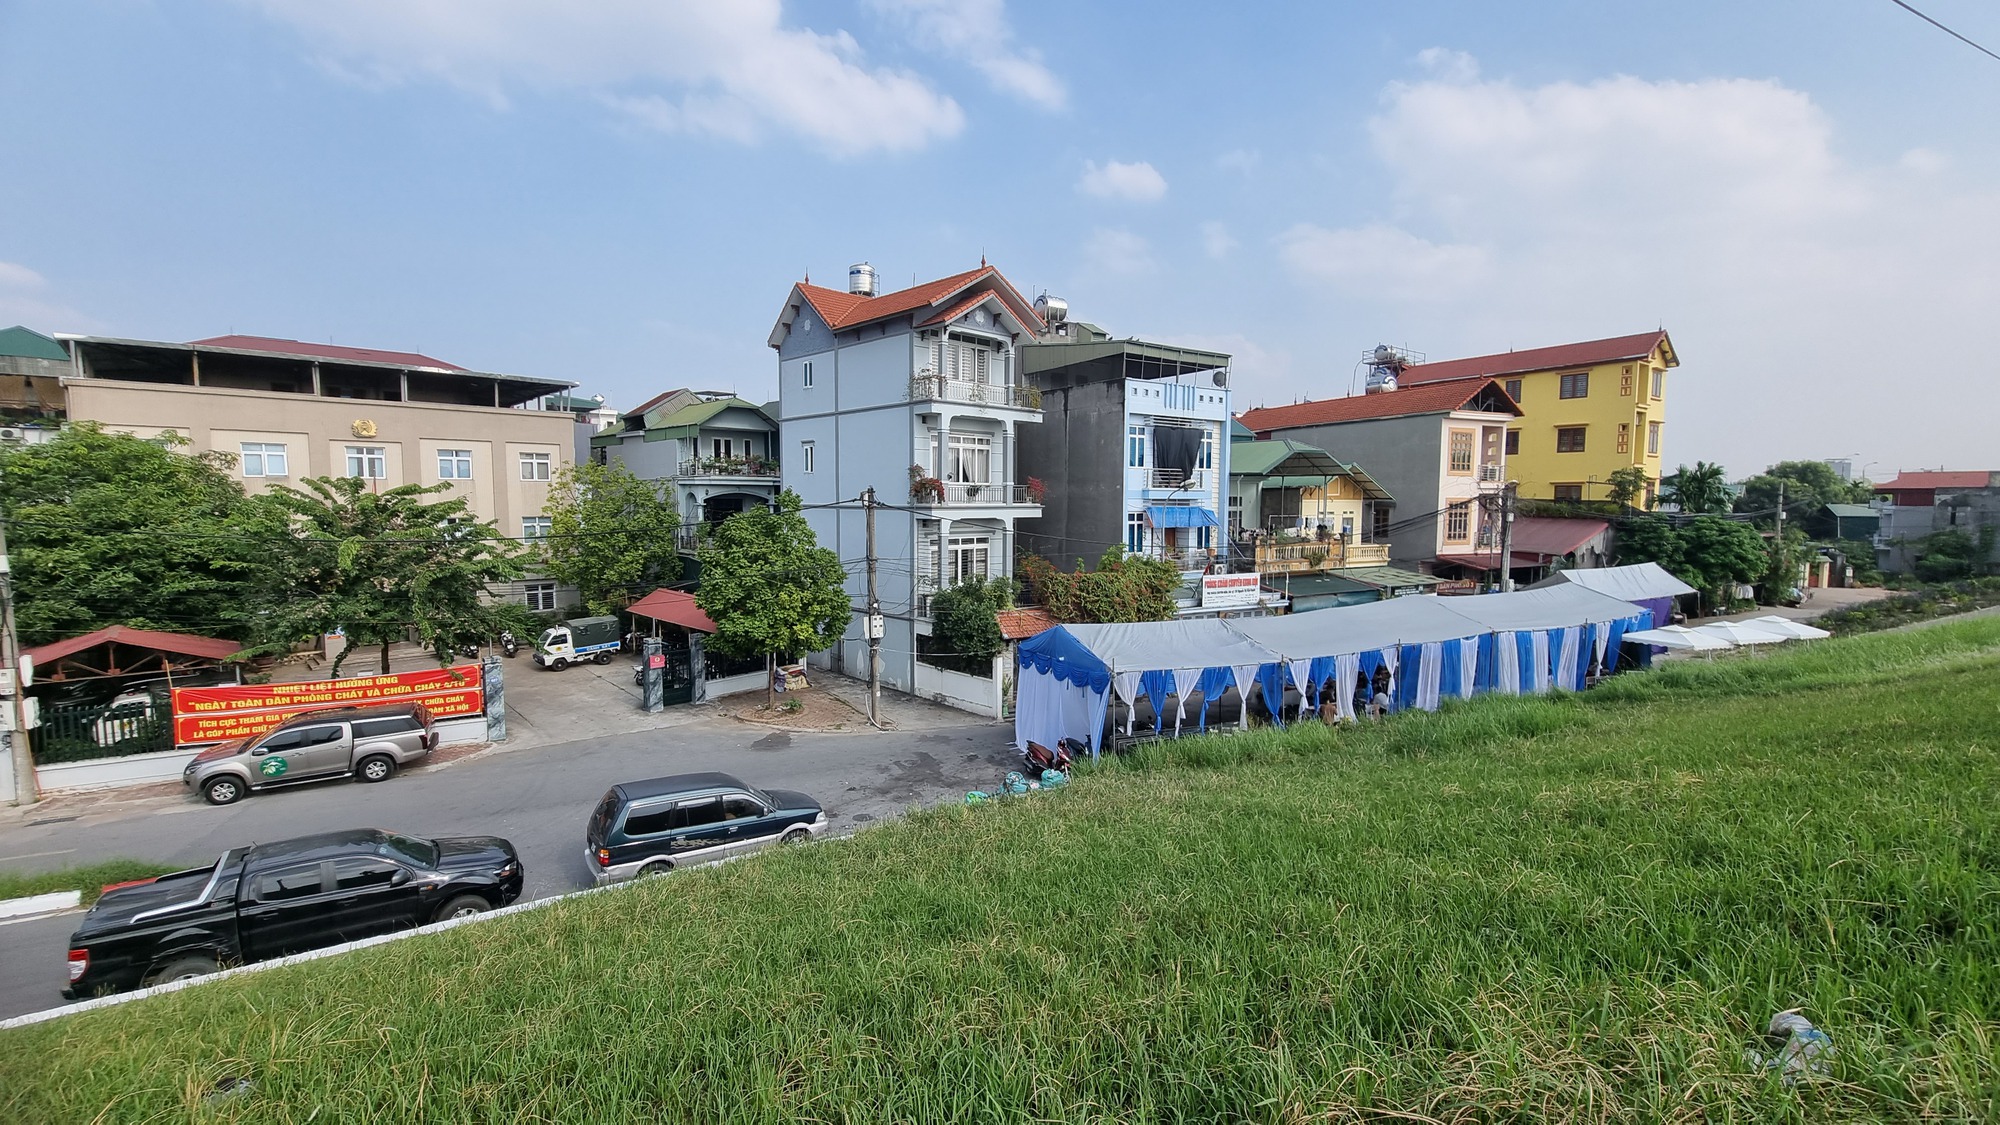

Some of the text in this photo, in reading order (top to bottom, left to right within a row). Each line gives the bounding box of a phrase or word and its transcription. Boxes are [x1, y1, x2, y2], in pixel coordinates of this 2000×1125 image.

[230, 698, 262, 708] TOÀN
[266, 696, 290, 706] DÂN
[293, 692, 332, 703] PHÒNG
[335, 690, 364, 700] CHÁY
[366, 688, 380, 697] VÀ
[384, 685, 412, 696] CHỮA
[414, 682, 442, 692] CHÁY
[272, 684, 307, 694] NHIỆT
[310, 682, 333, 692] LIỆT
[198, 720, 218, 728] TÍCH
[219, 718, 238, 728] CỰC
[239, 716, 264, 725] THAM
[266, 713, 280, 722] GIA
[446, 695, 464, 704] CHÁY
[194, 730, 204, 738] LÀ
[206, 728, 224, 738] GÓP
